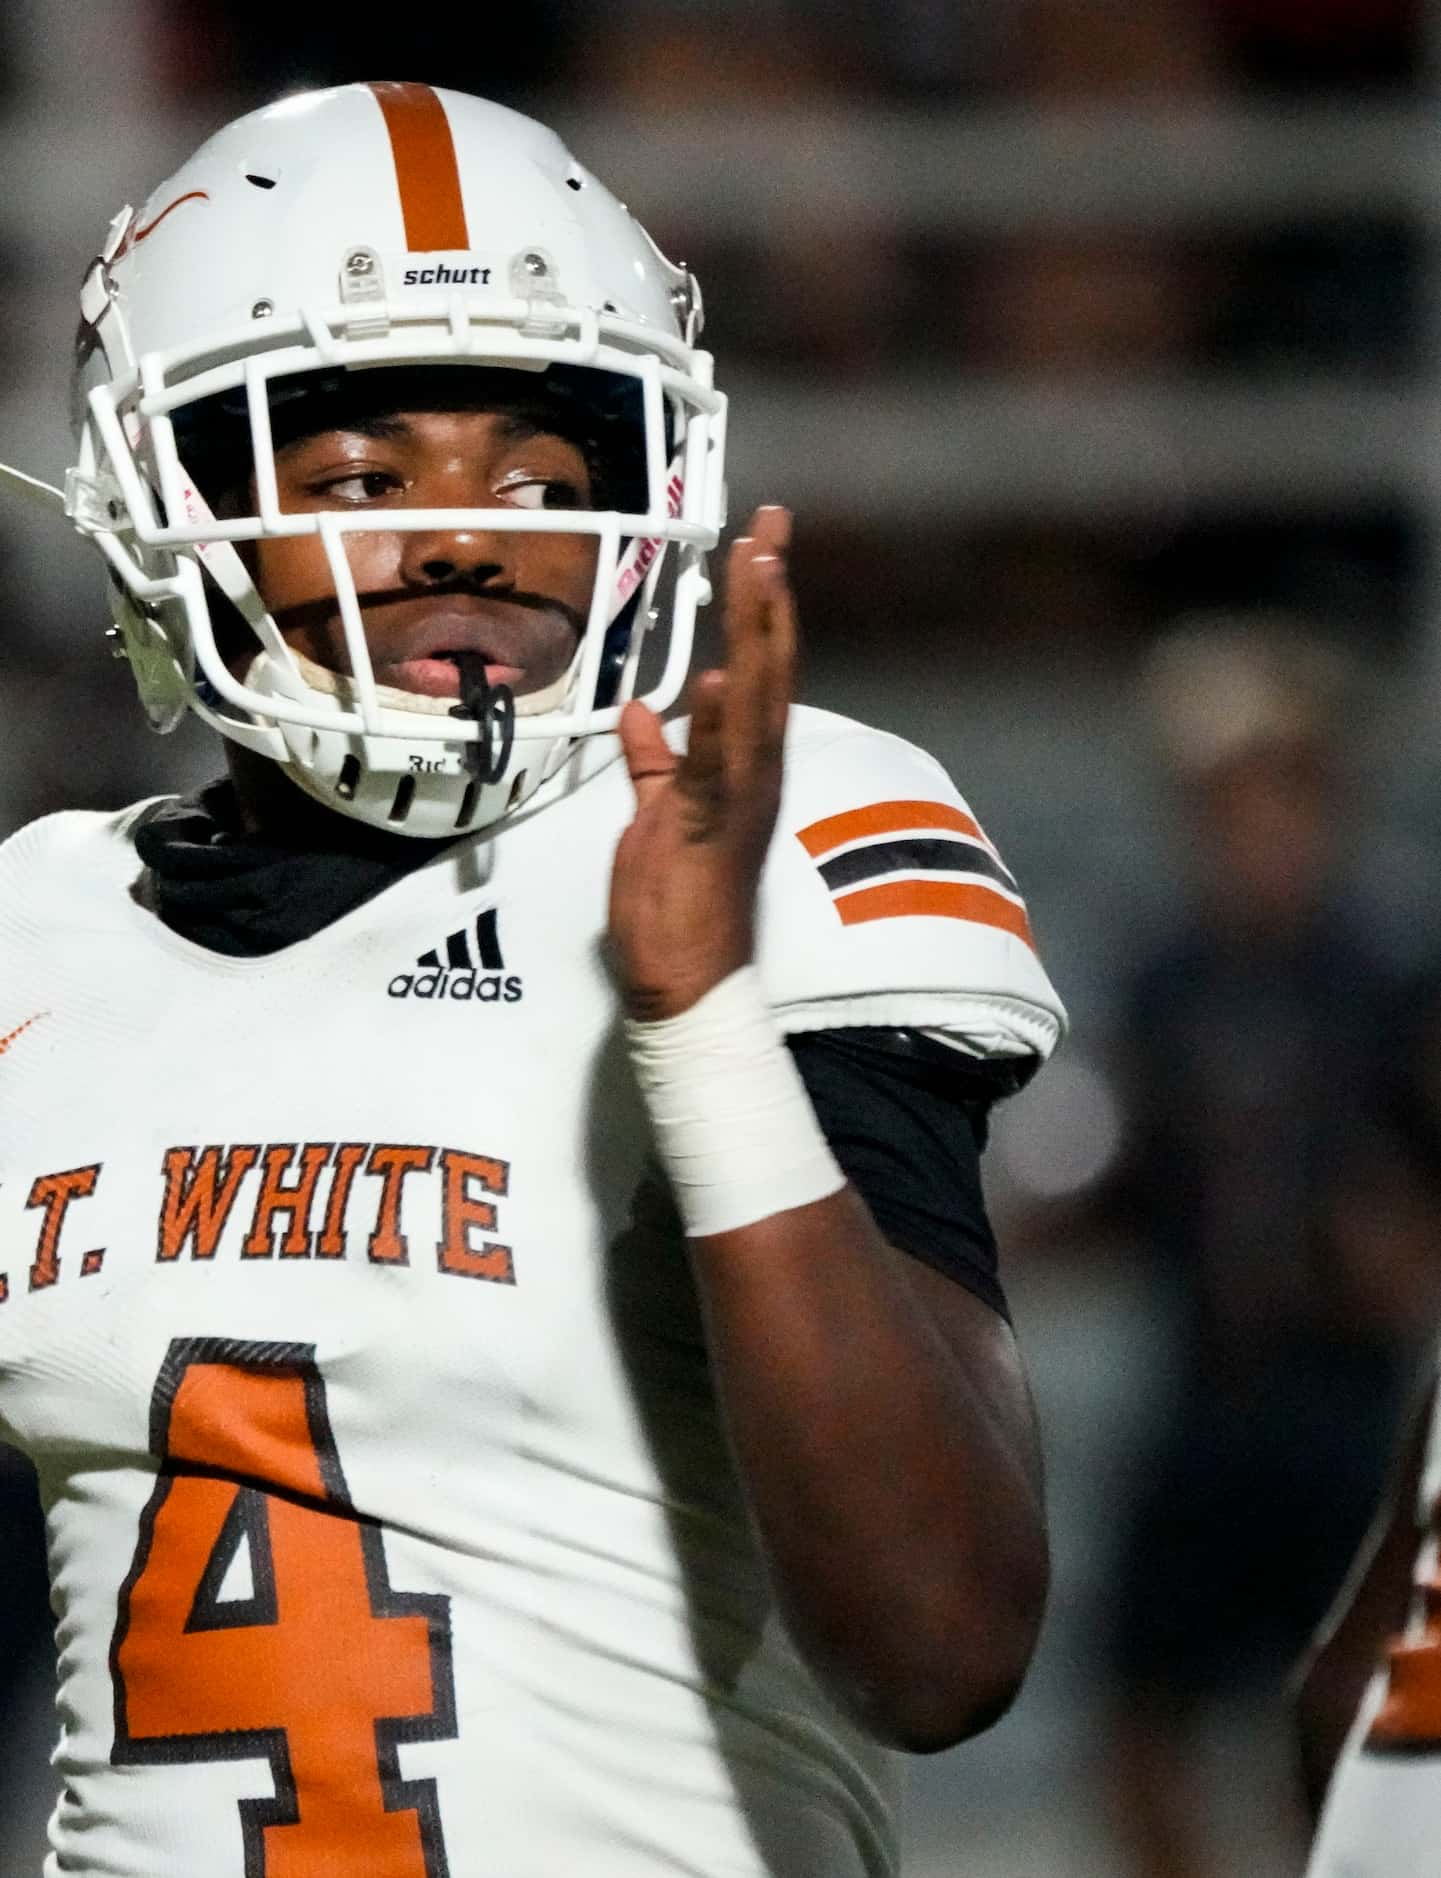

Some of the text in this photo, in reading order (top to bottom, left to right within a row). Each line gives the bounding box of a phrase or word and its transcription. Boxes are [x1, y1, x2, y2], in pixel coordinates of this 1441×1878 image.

[403, 264, 491, 285] schutt
[387, 966, 523, 1002] adidas
[156, 1142, 517, 1286] WHITE
[109, 1337, 459, 1878] 4
